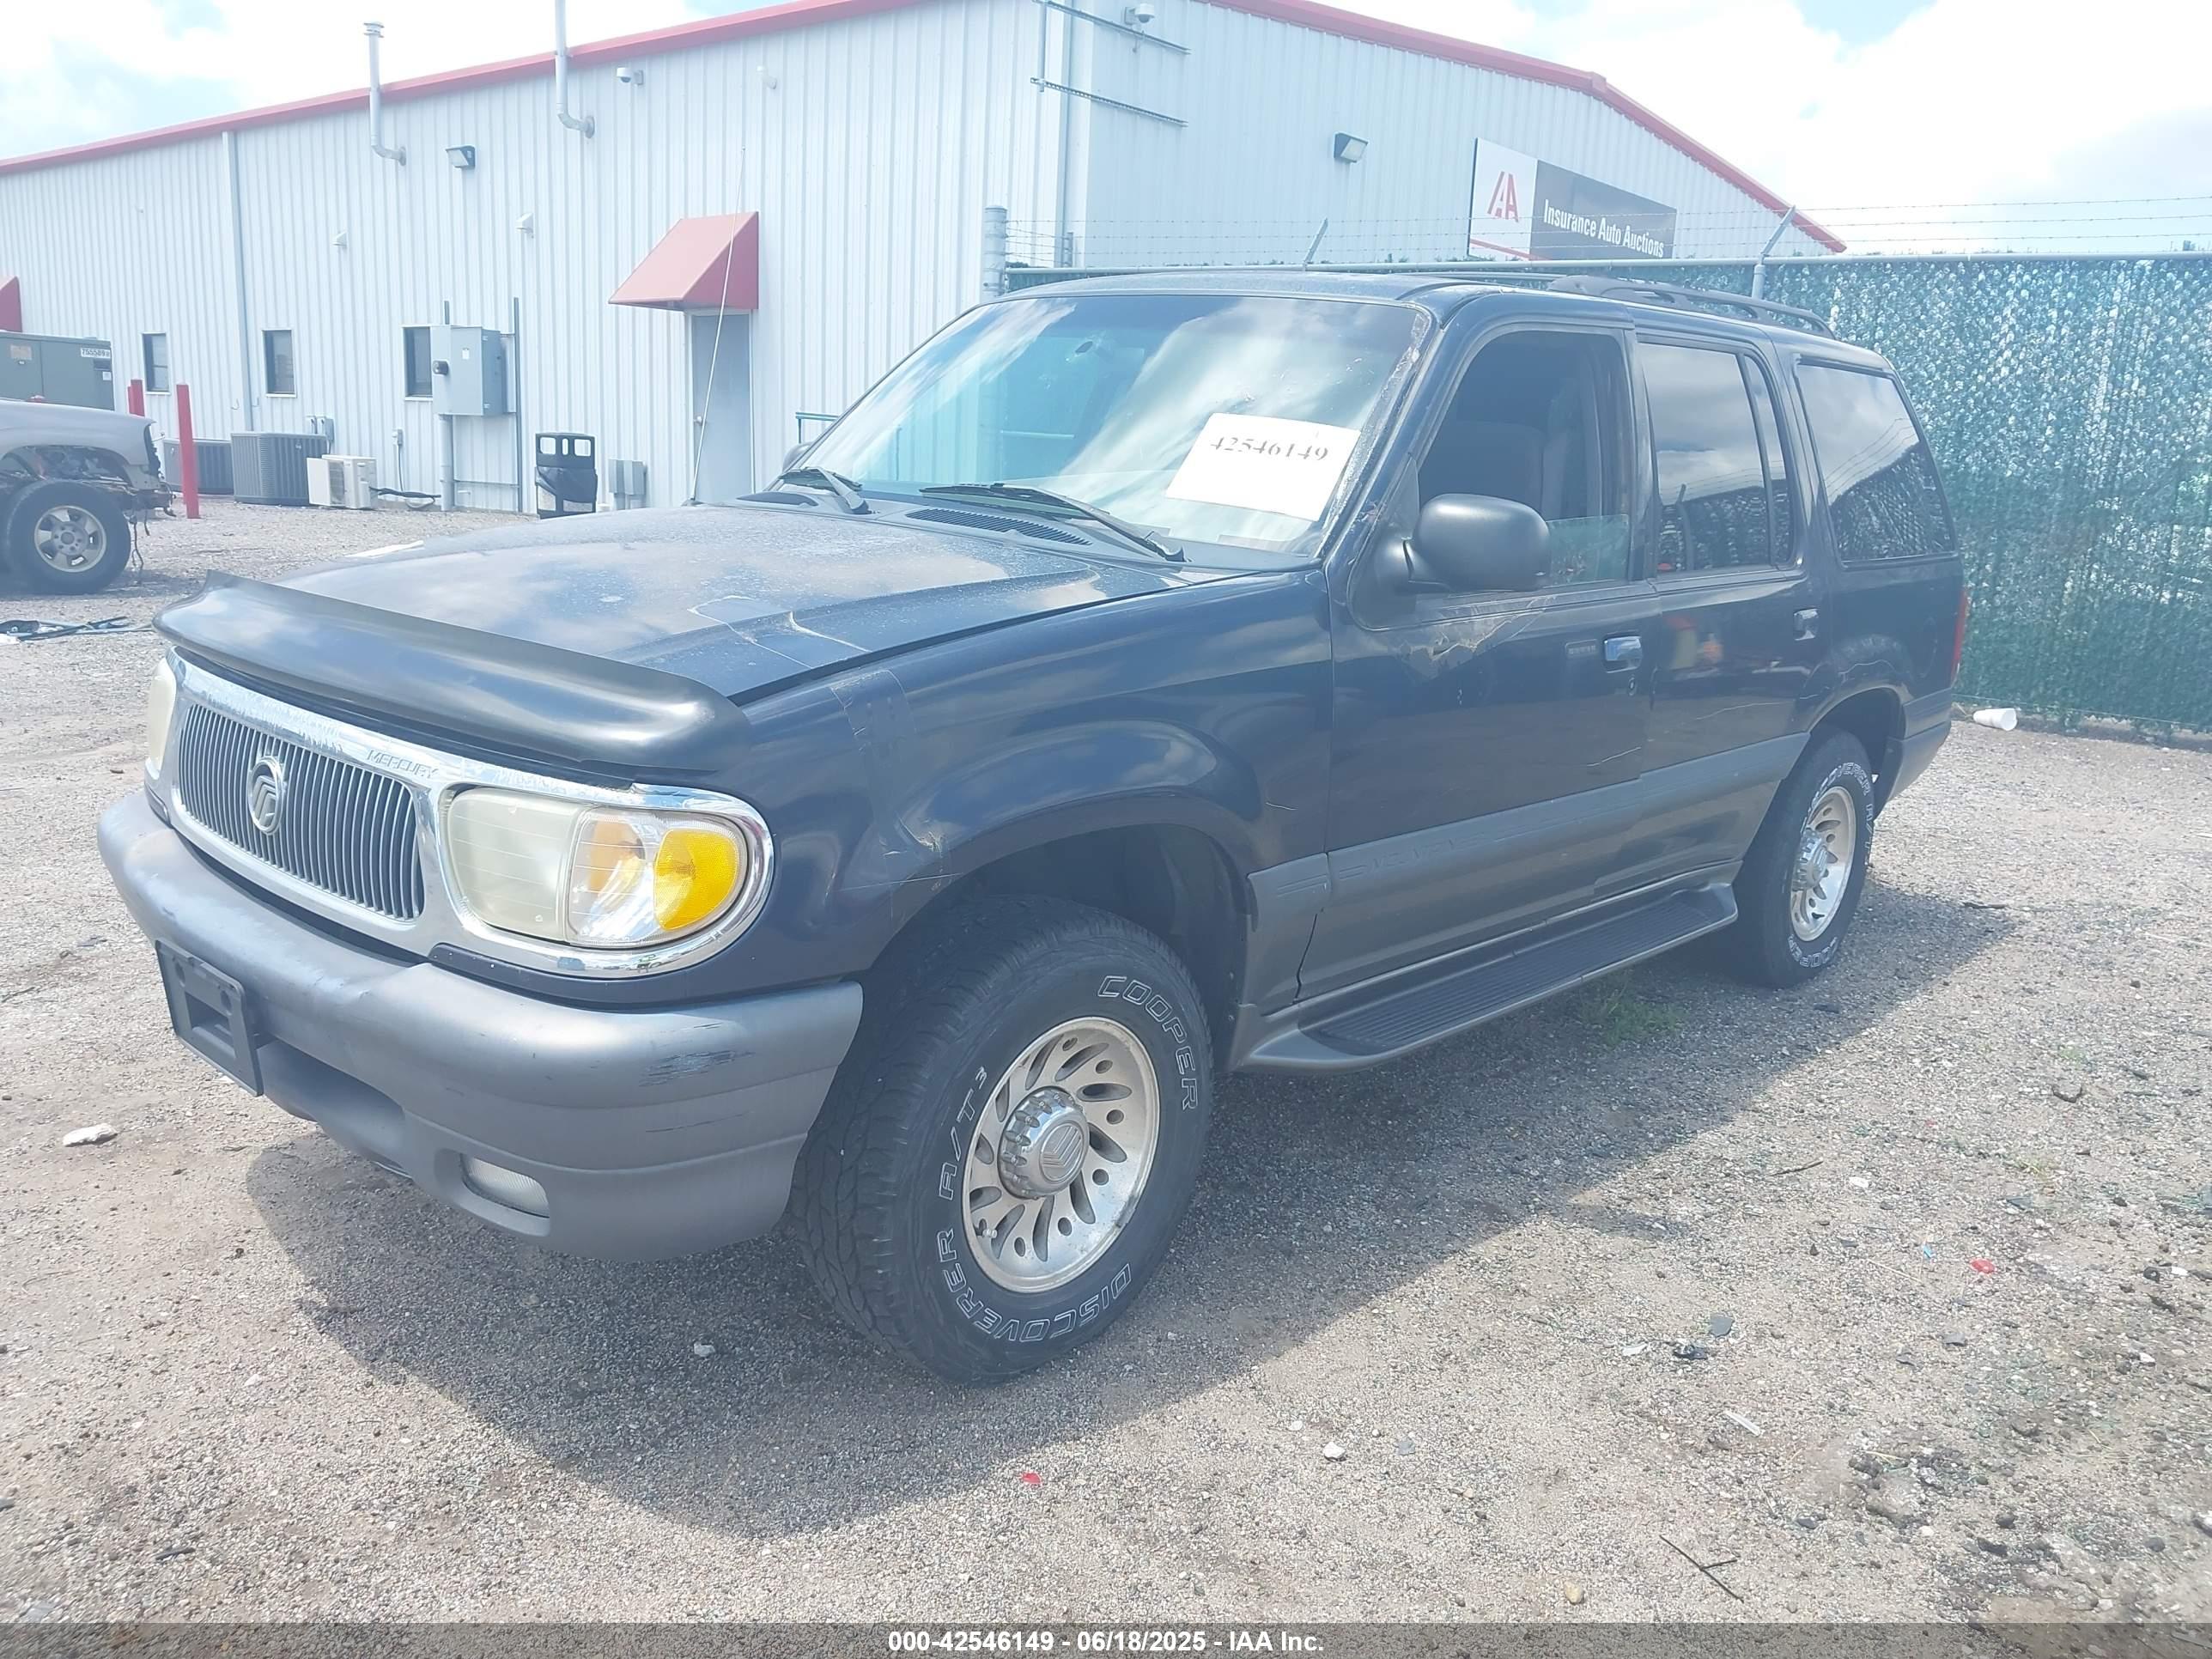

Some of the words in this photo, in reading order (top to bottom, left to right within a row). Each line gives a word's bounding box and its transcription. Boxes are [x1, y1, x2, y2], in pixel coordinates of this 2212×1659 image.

[1543, 198, 1597, 238] Insurance
[1597, 216, 1622, 246] Auto
[1622, 224, 1665, 258] Auctions
[1210, 436, 1329, 462] 42546149
[367, 749, 440, 780] MERCURY
[1097, 975, 1199, 1111] COOPER
[936, 1227, 1133, 1343] DISCOVERER
